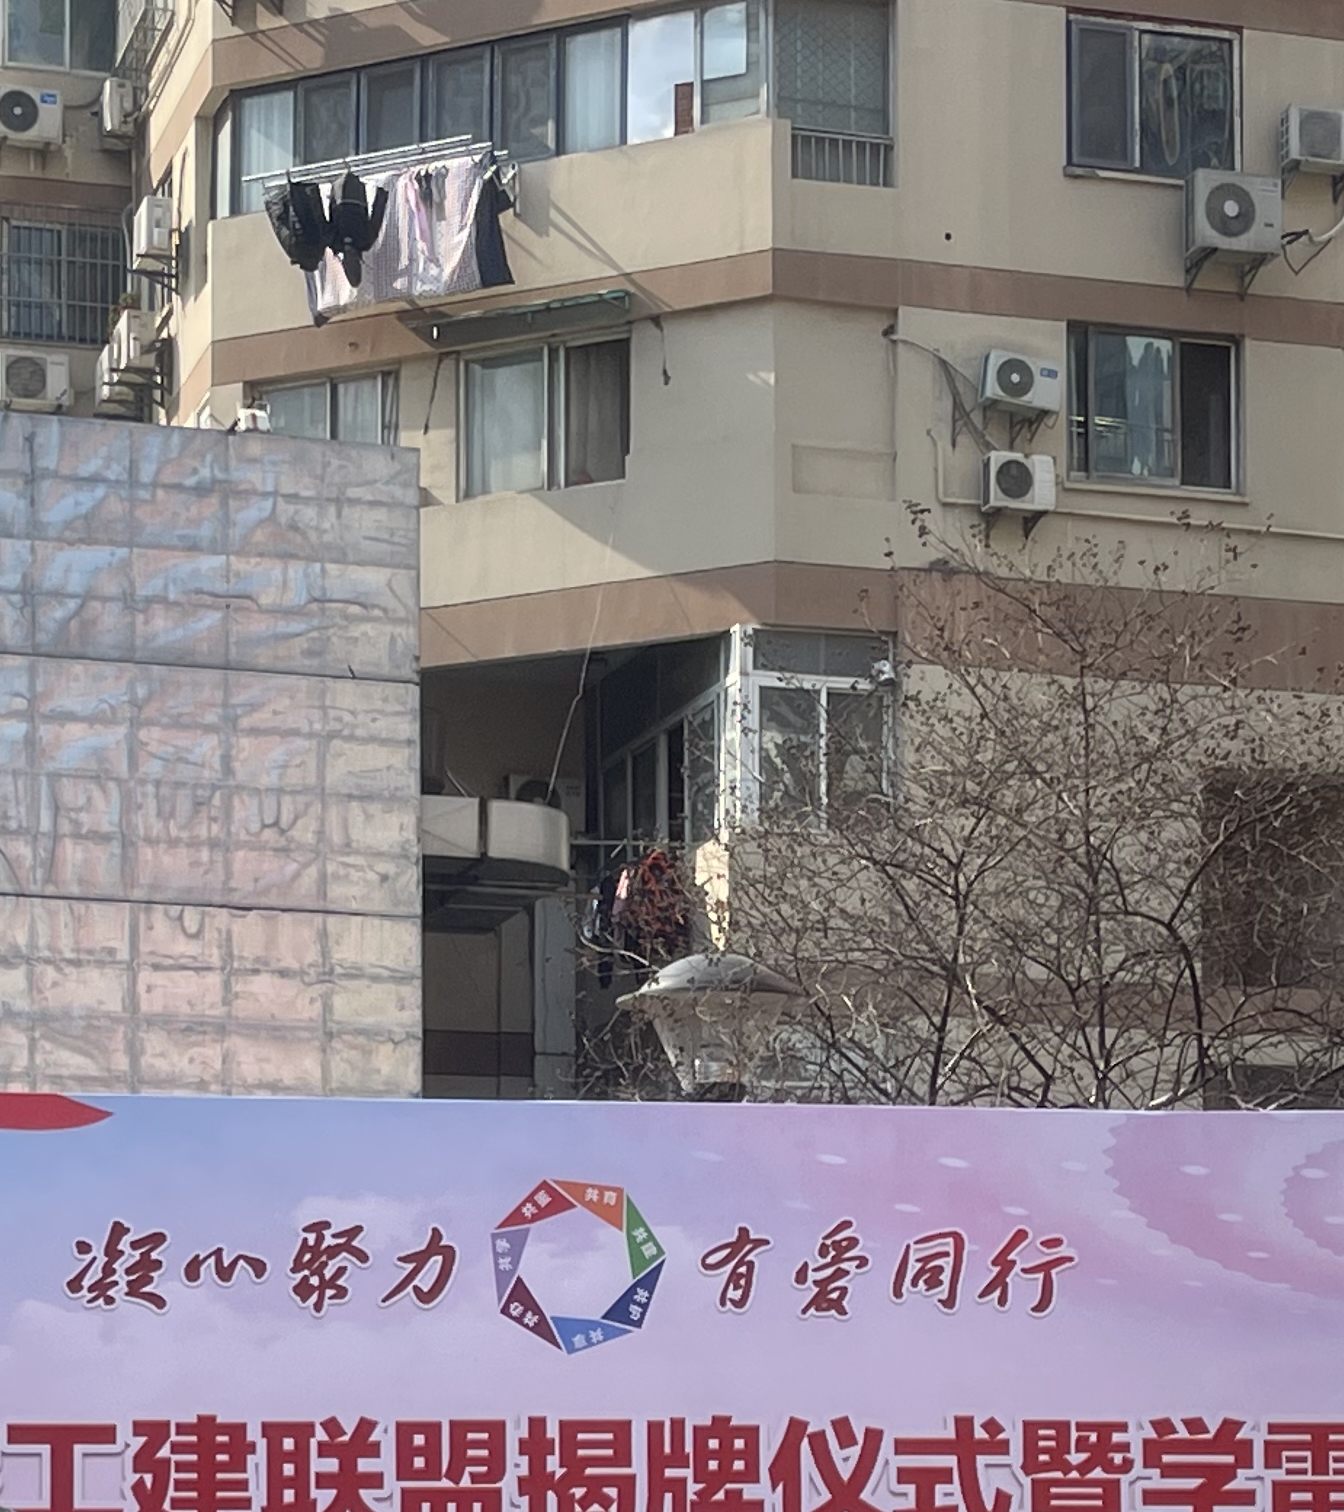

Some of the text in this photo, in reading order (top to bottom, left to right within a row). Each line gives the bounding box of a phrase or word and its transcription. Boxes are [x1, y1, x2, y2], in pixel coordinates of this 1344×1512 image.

[65, 1219, 1080, 1317] 凝心聚力 有爱同行
